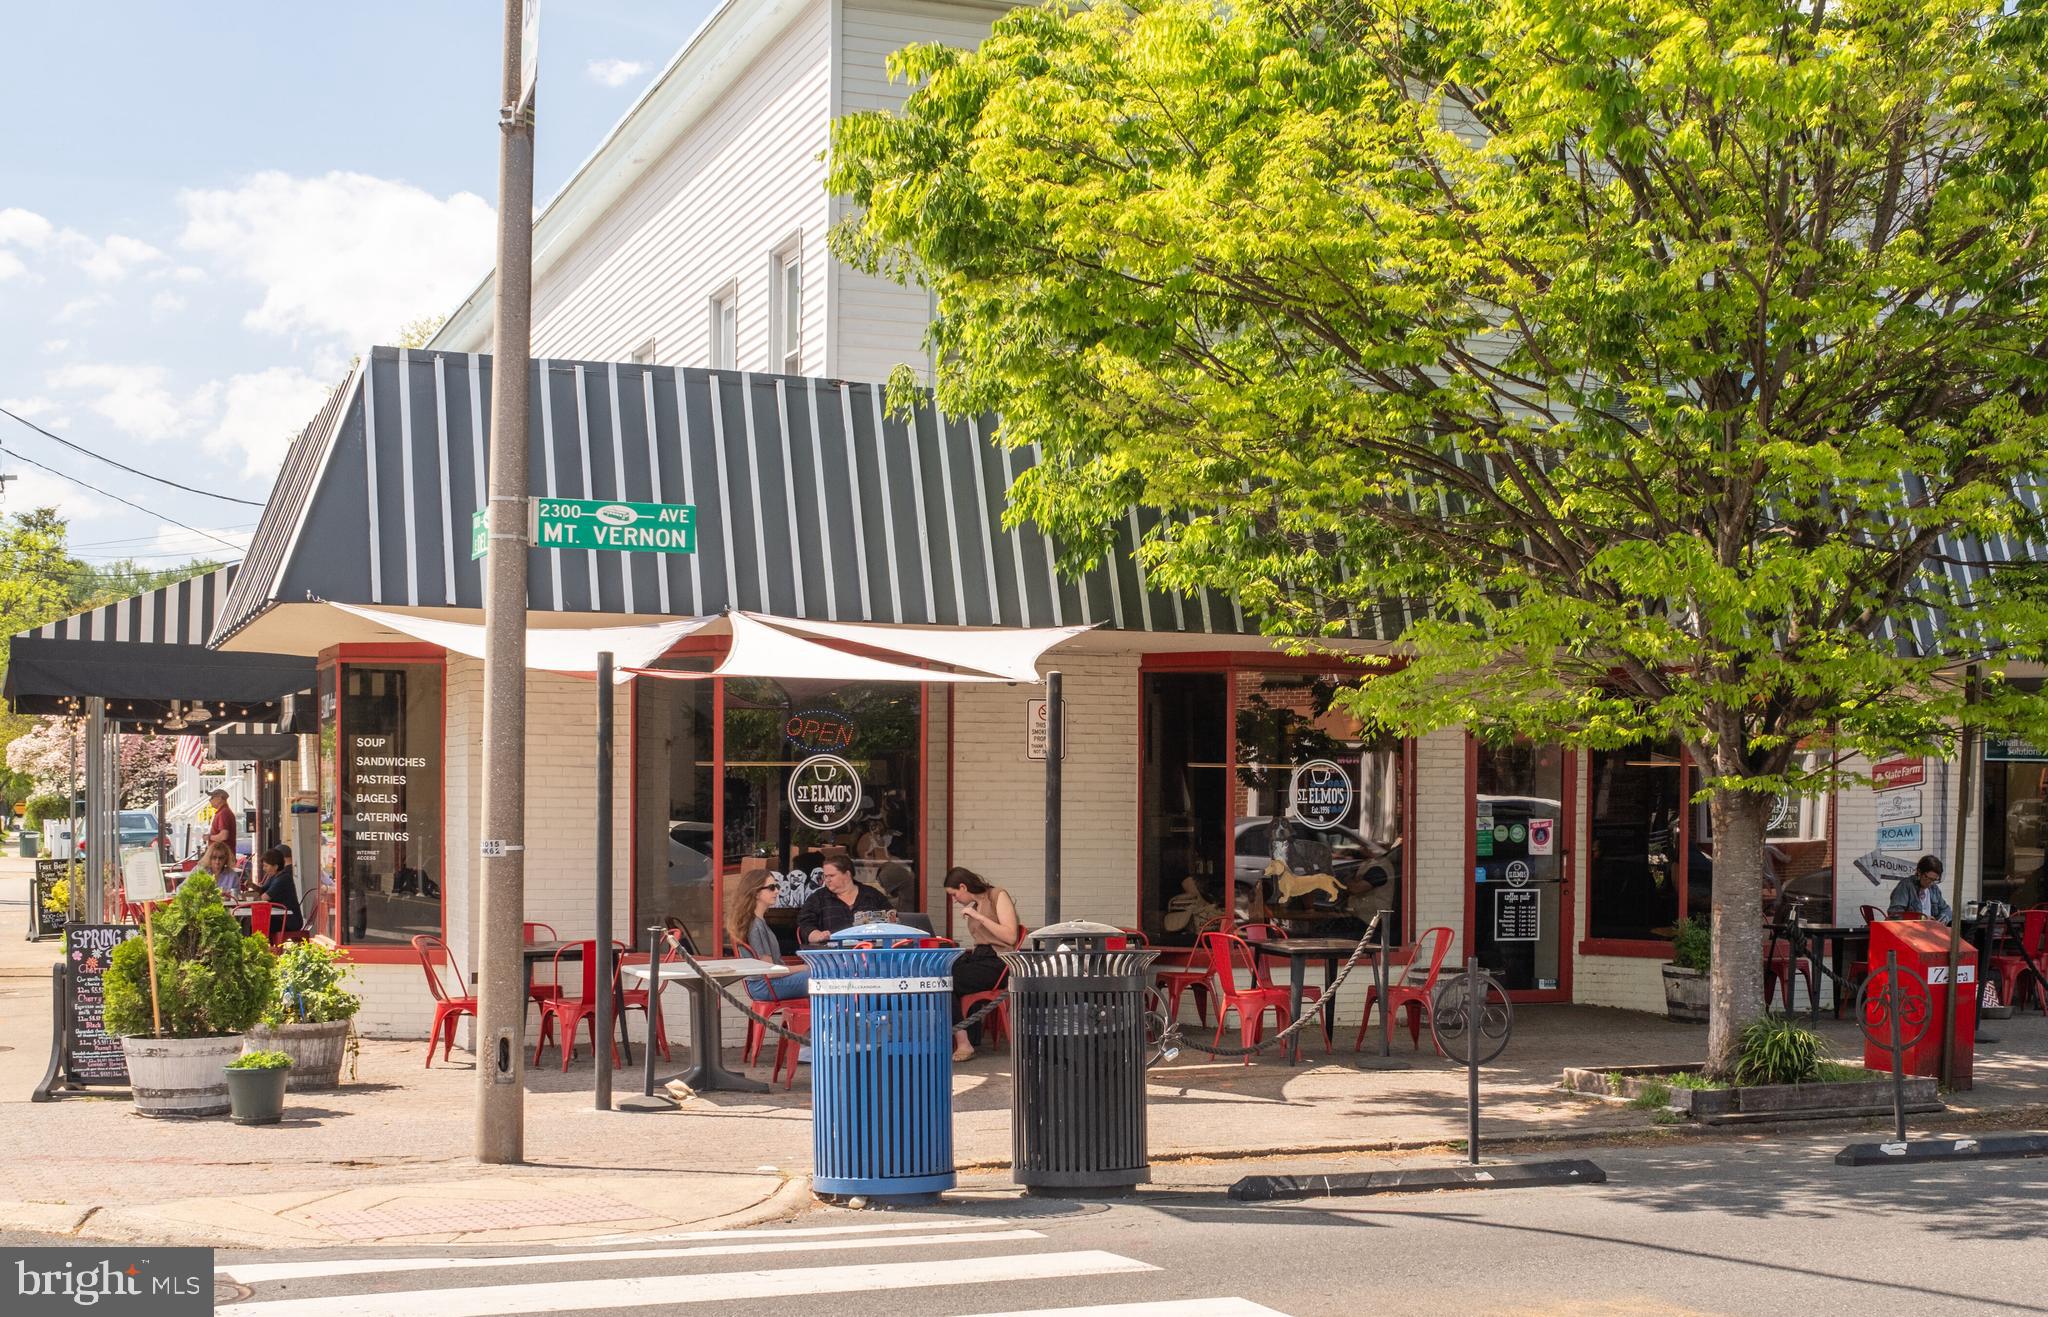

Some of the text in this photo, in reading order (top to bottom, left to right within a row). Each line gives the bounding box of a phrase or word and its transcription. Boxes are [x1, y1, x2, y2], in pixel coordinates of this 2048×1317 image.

[540, 504, 690, 523] 2300 AVE
[544, 522, 686, 548] MT. VERNON
[786, 717, 854, 746] OPEN
[356, 737, 386, 747] SOUP
[2008, 747, 2042, 756] Solutions
[356, 757, 426, 768] SANDWICHES
[356, 775, 407, 785] PASTRIES
[356, 794, 399, 804] BAGELS
[811, 784, 853, 803] ELMO'S
[1309, 787, 1345, 804] ELMO'S
[356, 812, 408, 823] CATERING
[355, 832, 410, 842] MEETINGS
[1881, 827, 1914, 839] ROAM
[1872, 858, 1908, 873] AROUND
[71, 928, 122, 950] SPRING
